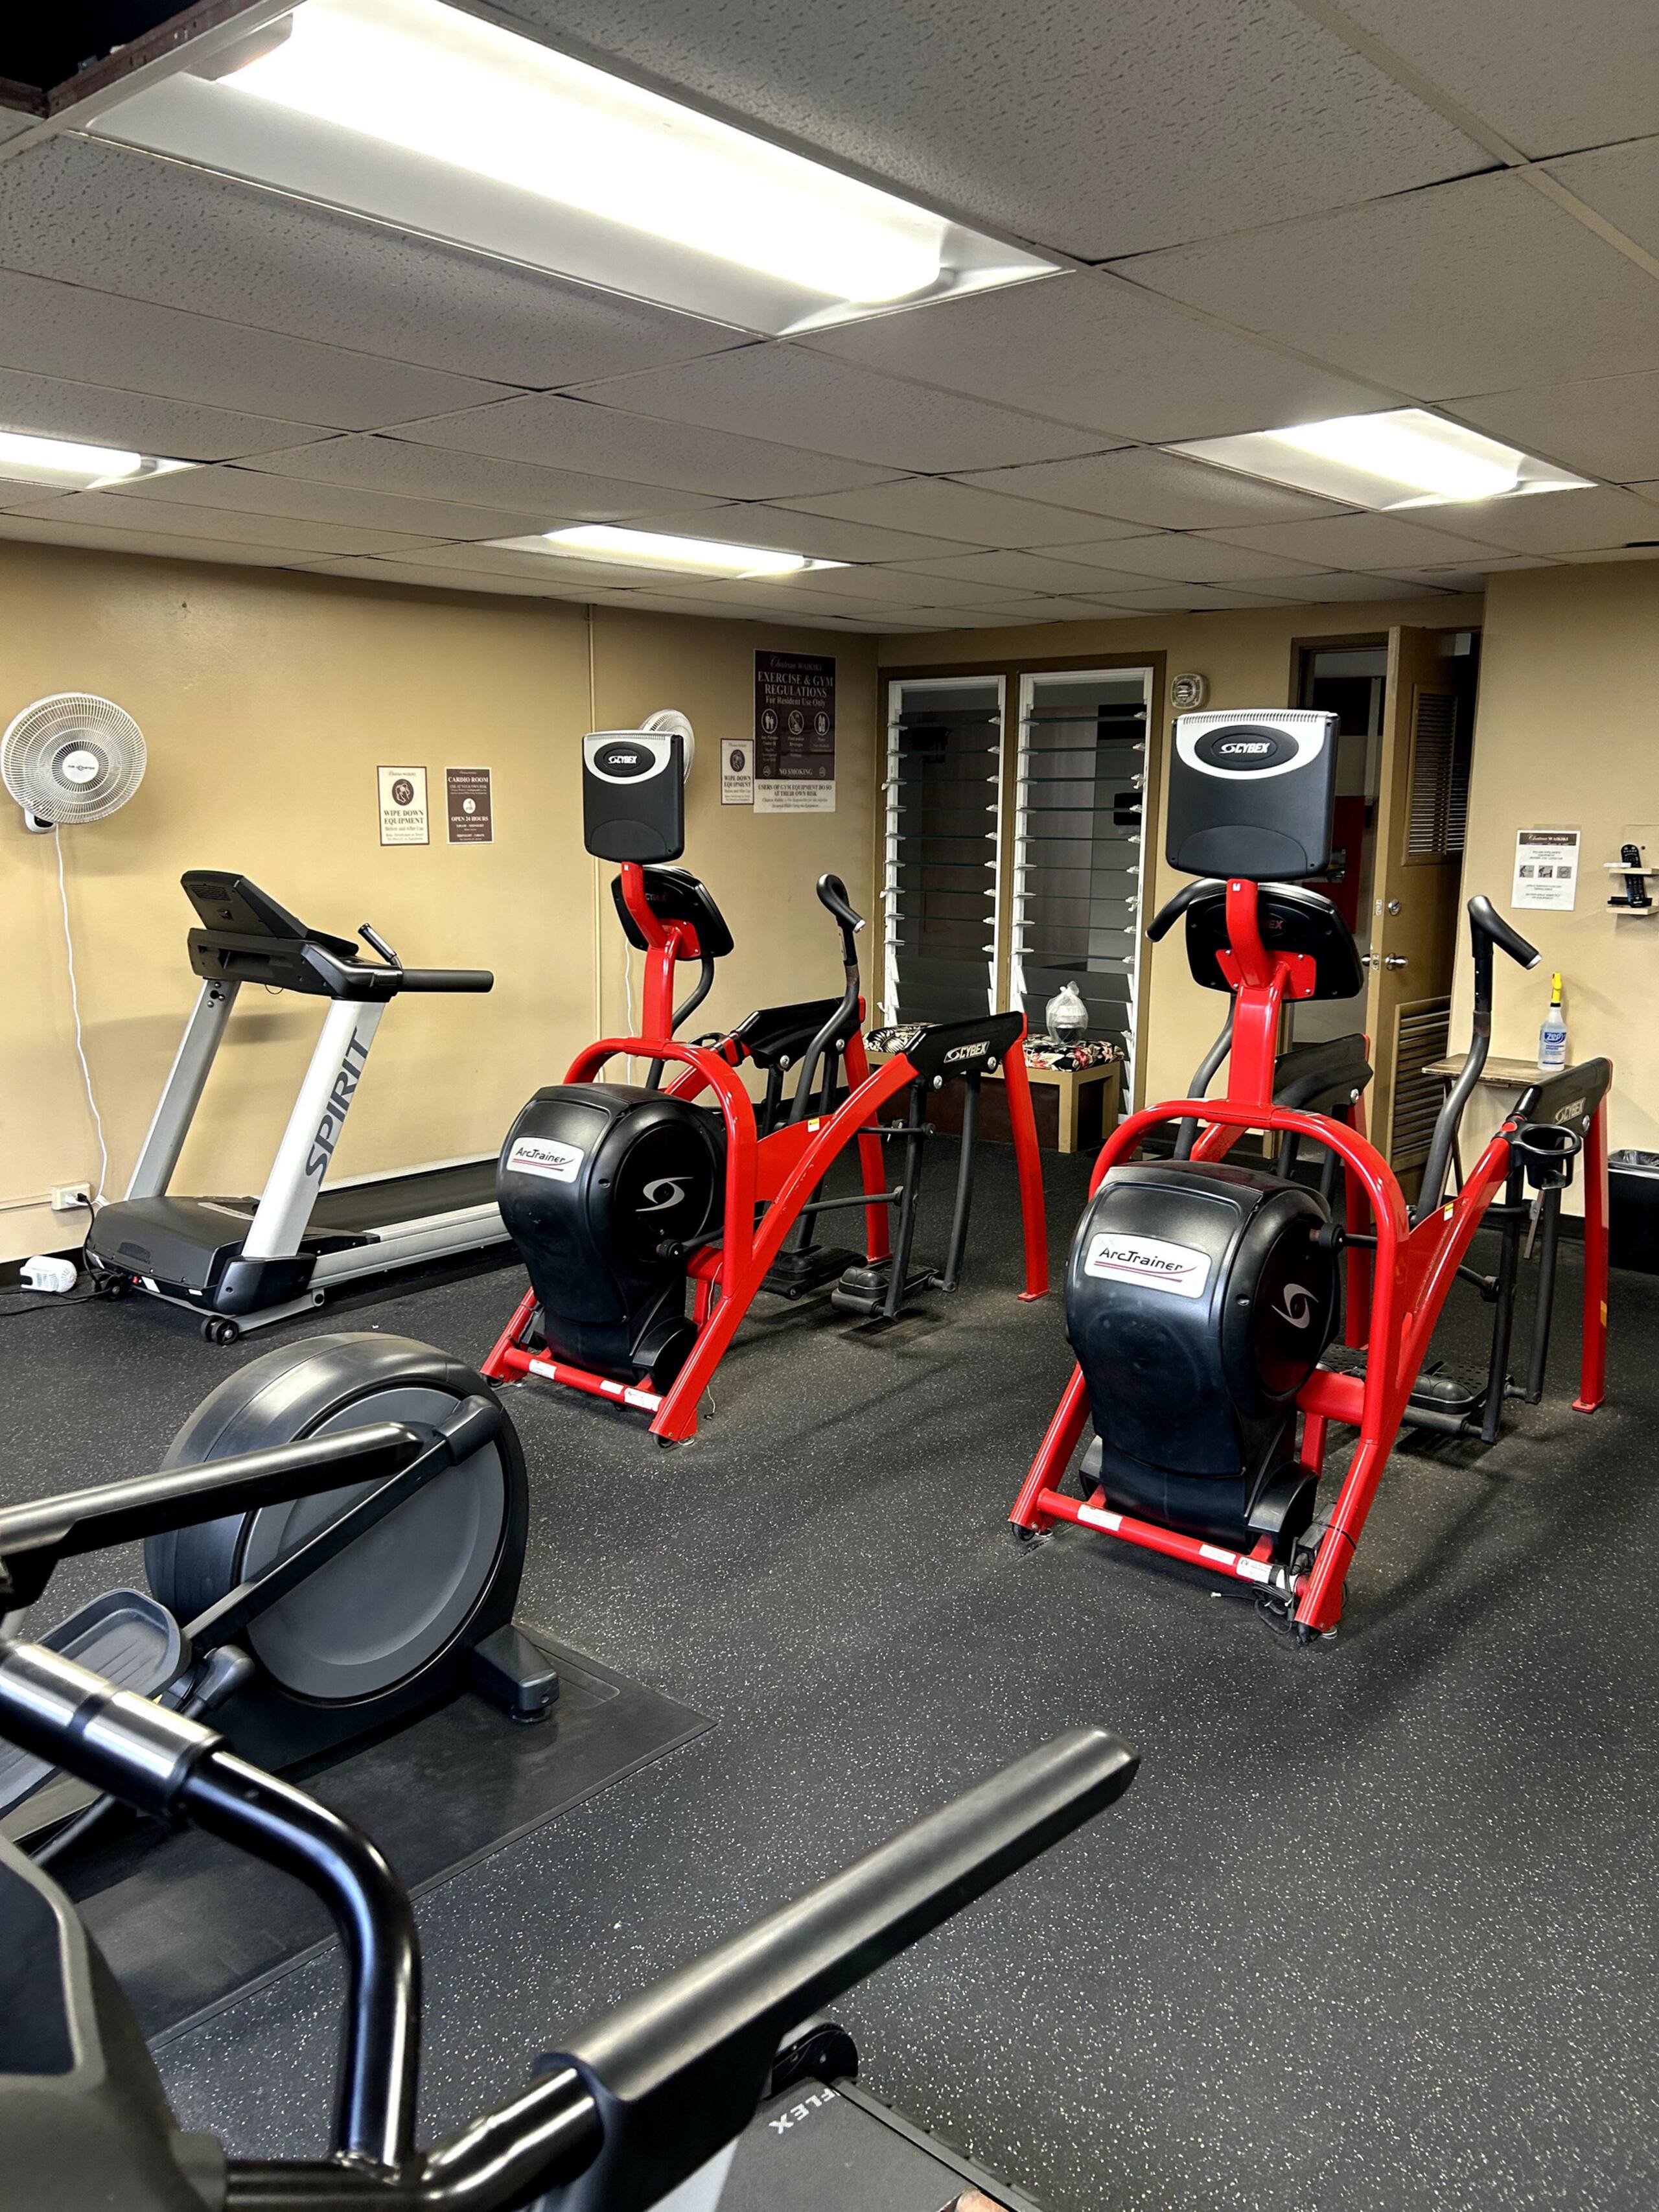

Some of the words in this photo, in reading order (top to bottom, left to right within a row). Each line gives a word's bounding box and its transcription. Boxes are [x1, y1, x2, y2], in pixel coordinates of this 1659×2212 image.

[758, 671, 802, 684] EXERCISE
[804, 675, 811, 685] &
[813, 675, 833, 686] GYM
[765, 684, 827, 697] REGULATIONS
[765, 695, 776, 704] For
[778, 697, 800, 706] Resident
[813, 699, 825, 708] Only
[1234, 743, 1270, 754] CYBEX
[617, 756, 637, 764] CYBEX
[959, 1042, 988, 1058] CYBEX
[305, 1026, 369, 1186] SPIRIT
[516, 1147, 566, 1163] ArcTrainer
[1098, 1247, 1183, 1271] ArcTrainer
